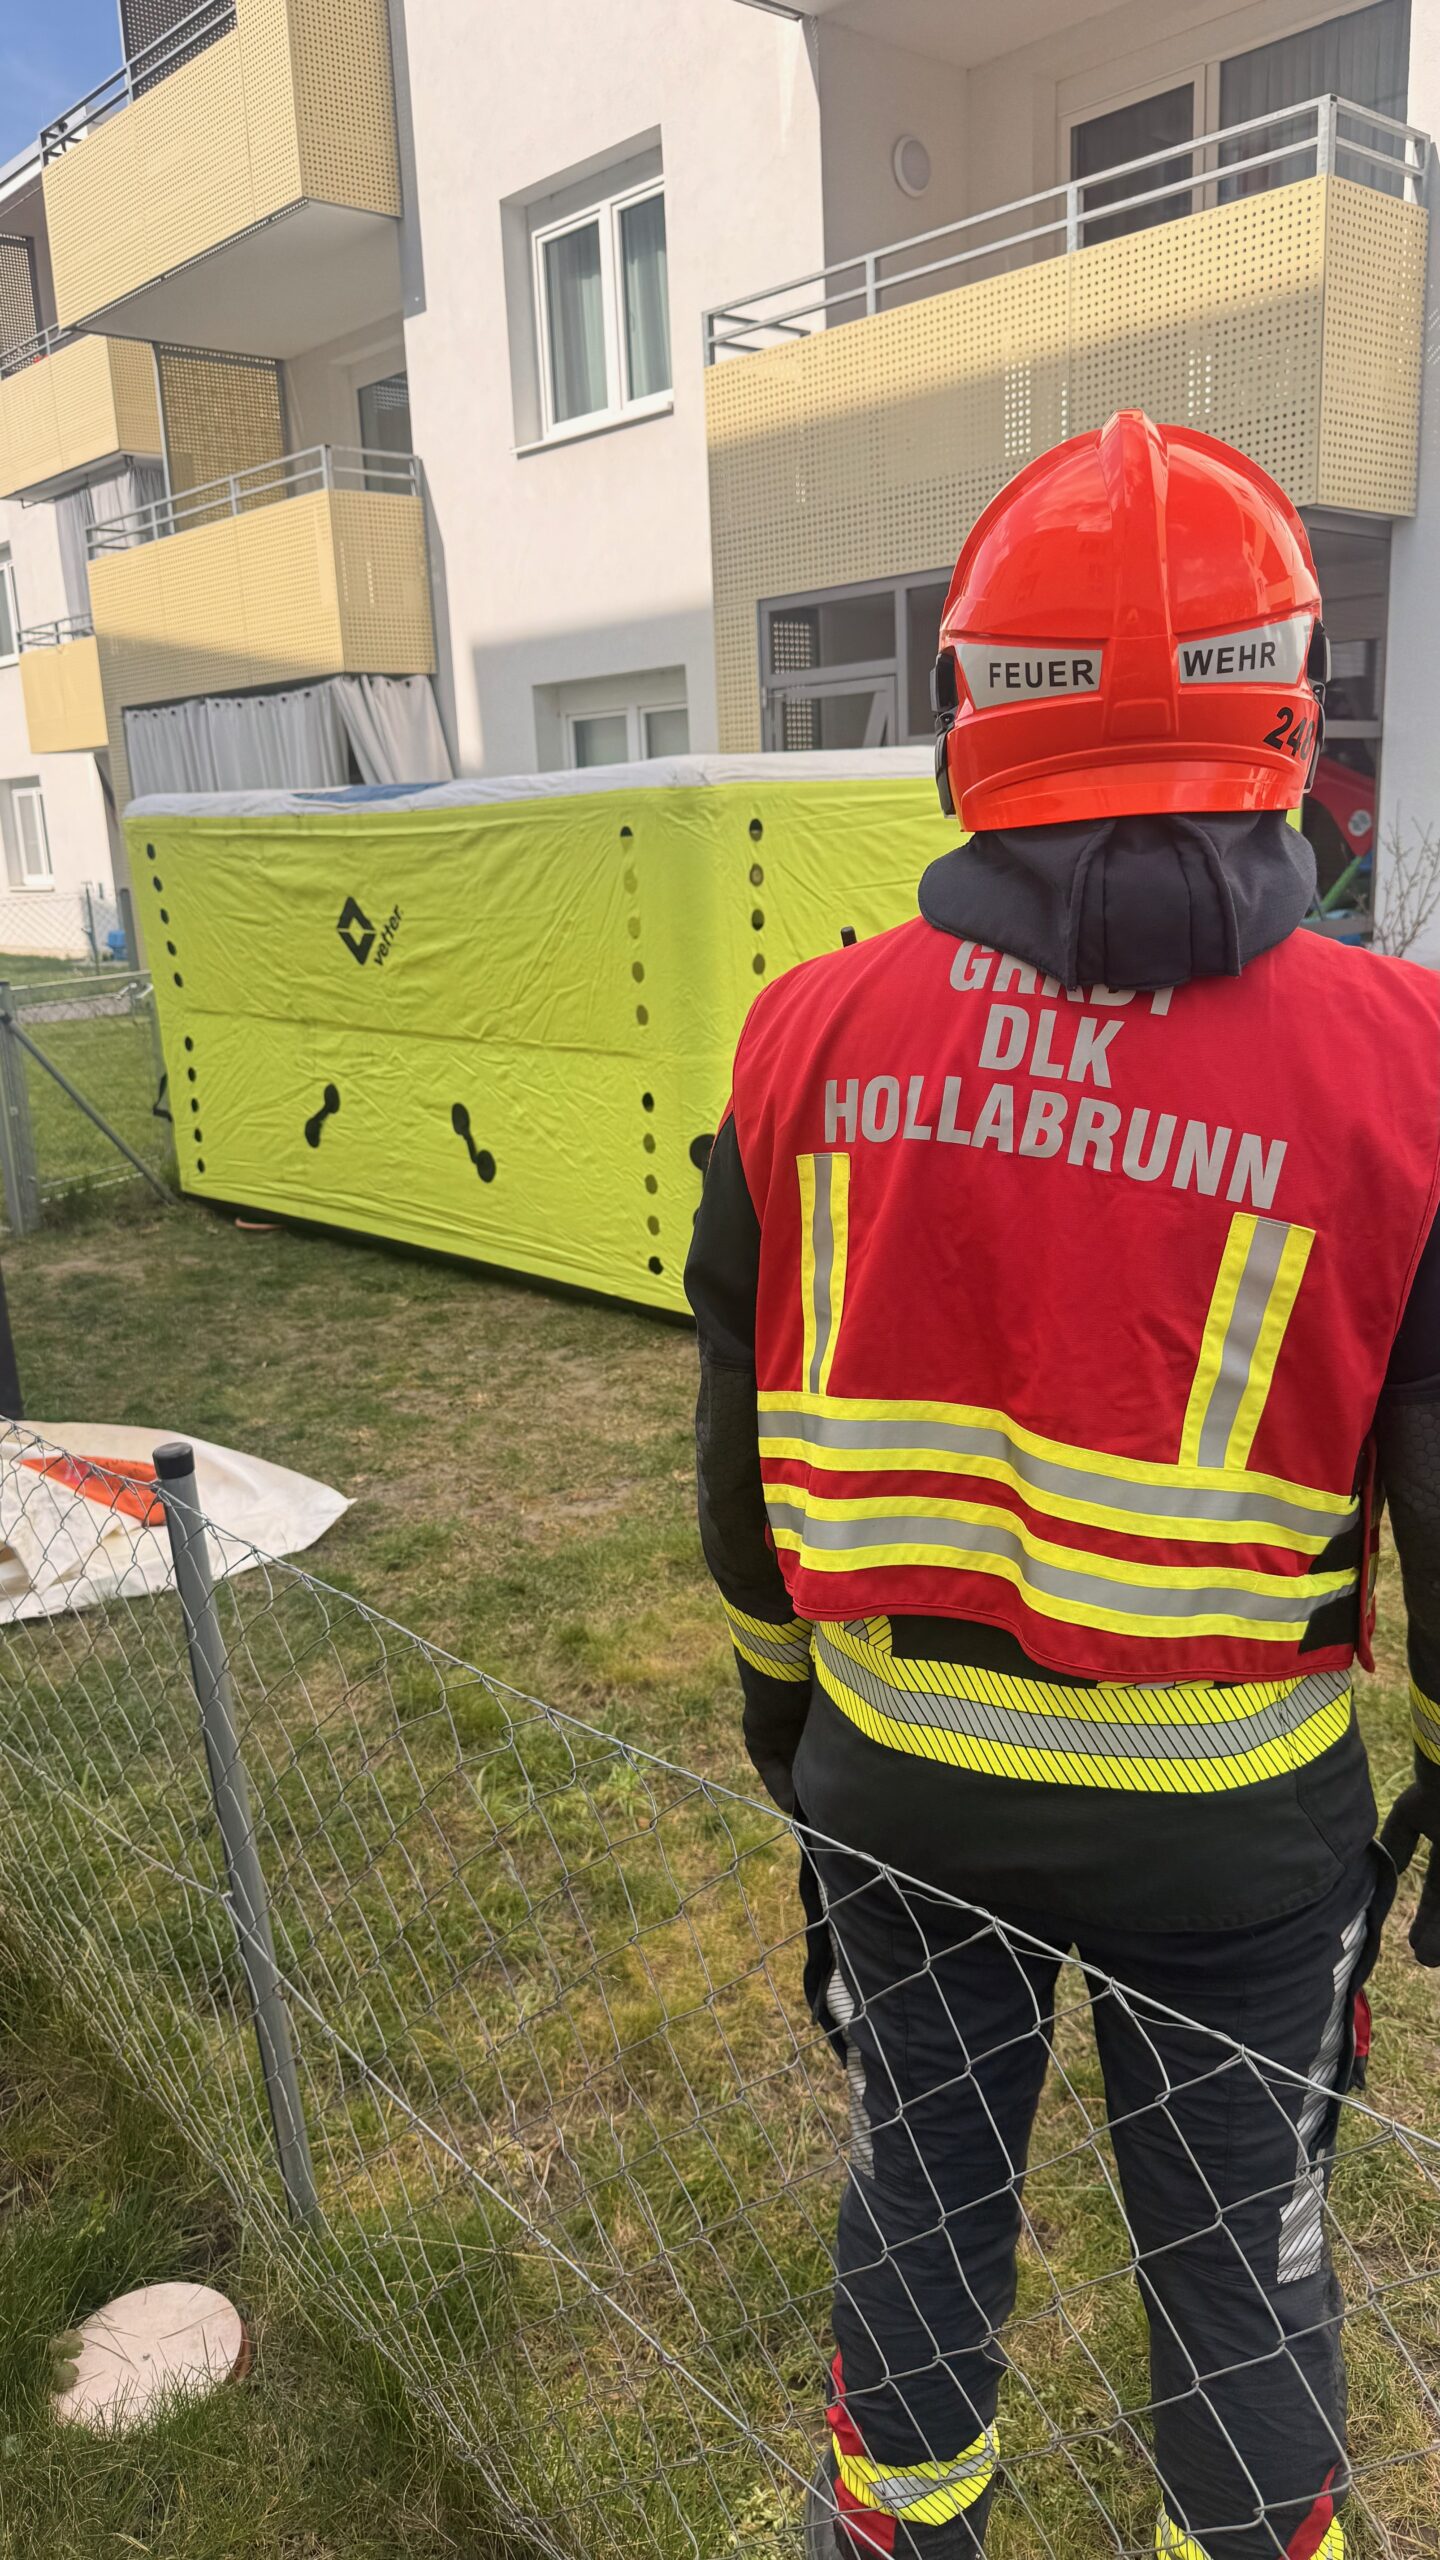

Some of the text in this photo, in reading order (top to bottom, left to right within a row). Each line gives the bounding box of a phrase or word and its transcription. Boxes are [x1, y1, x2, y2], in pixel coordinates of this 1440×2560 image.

[989, 641, 1276, 689] FEUER WEHR
[373, 904, 402, 967] vetter
[978, 1004, 1124, 1088] DLK
[824, 1075, 1288, 1209] HOLLABRUNN
